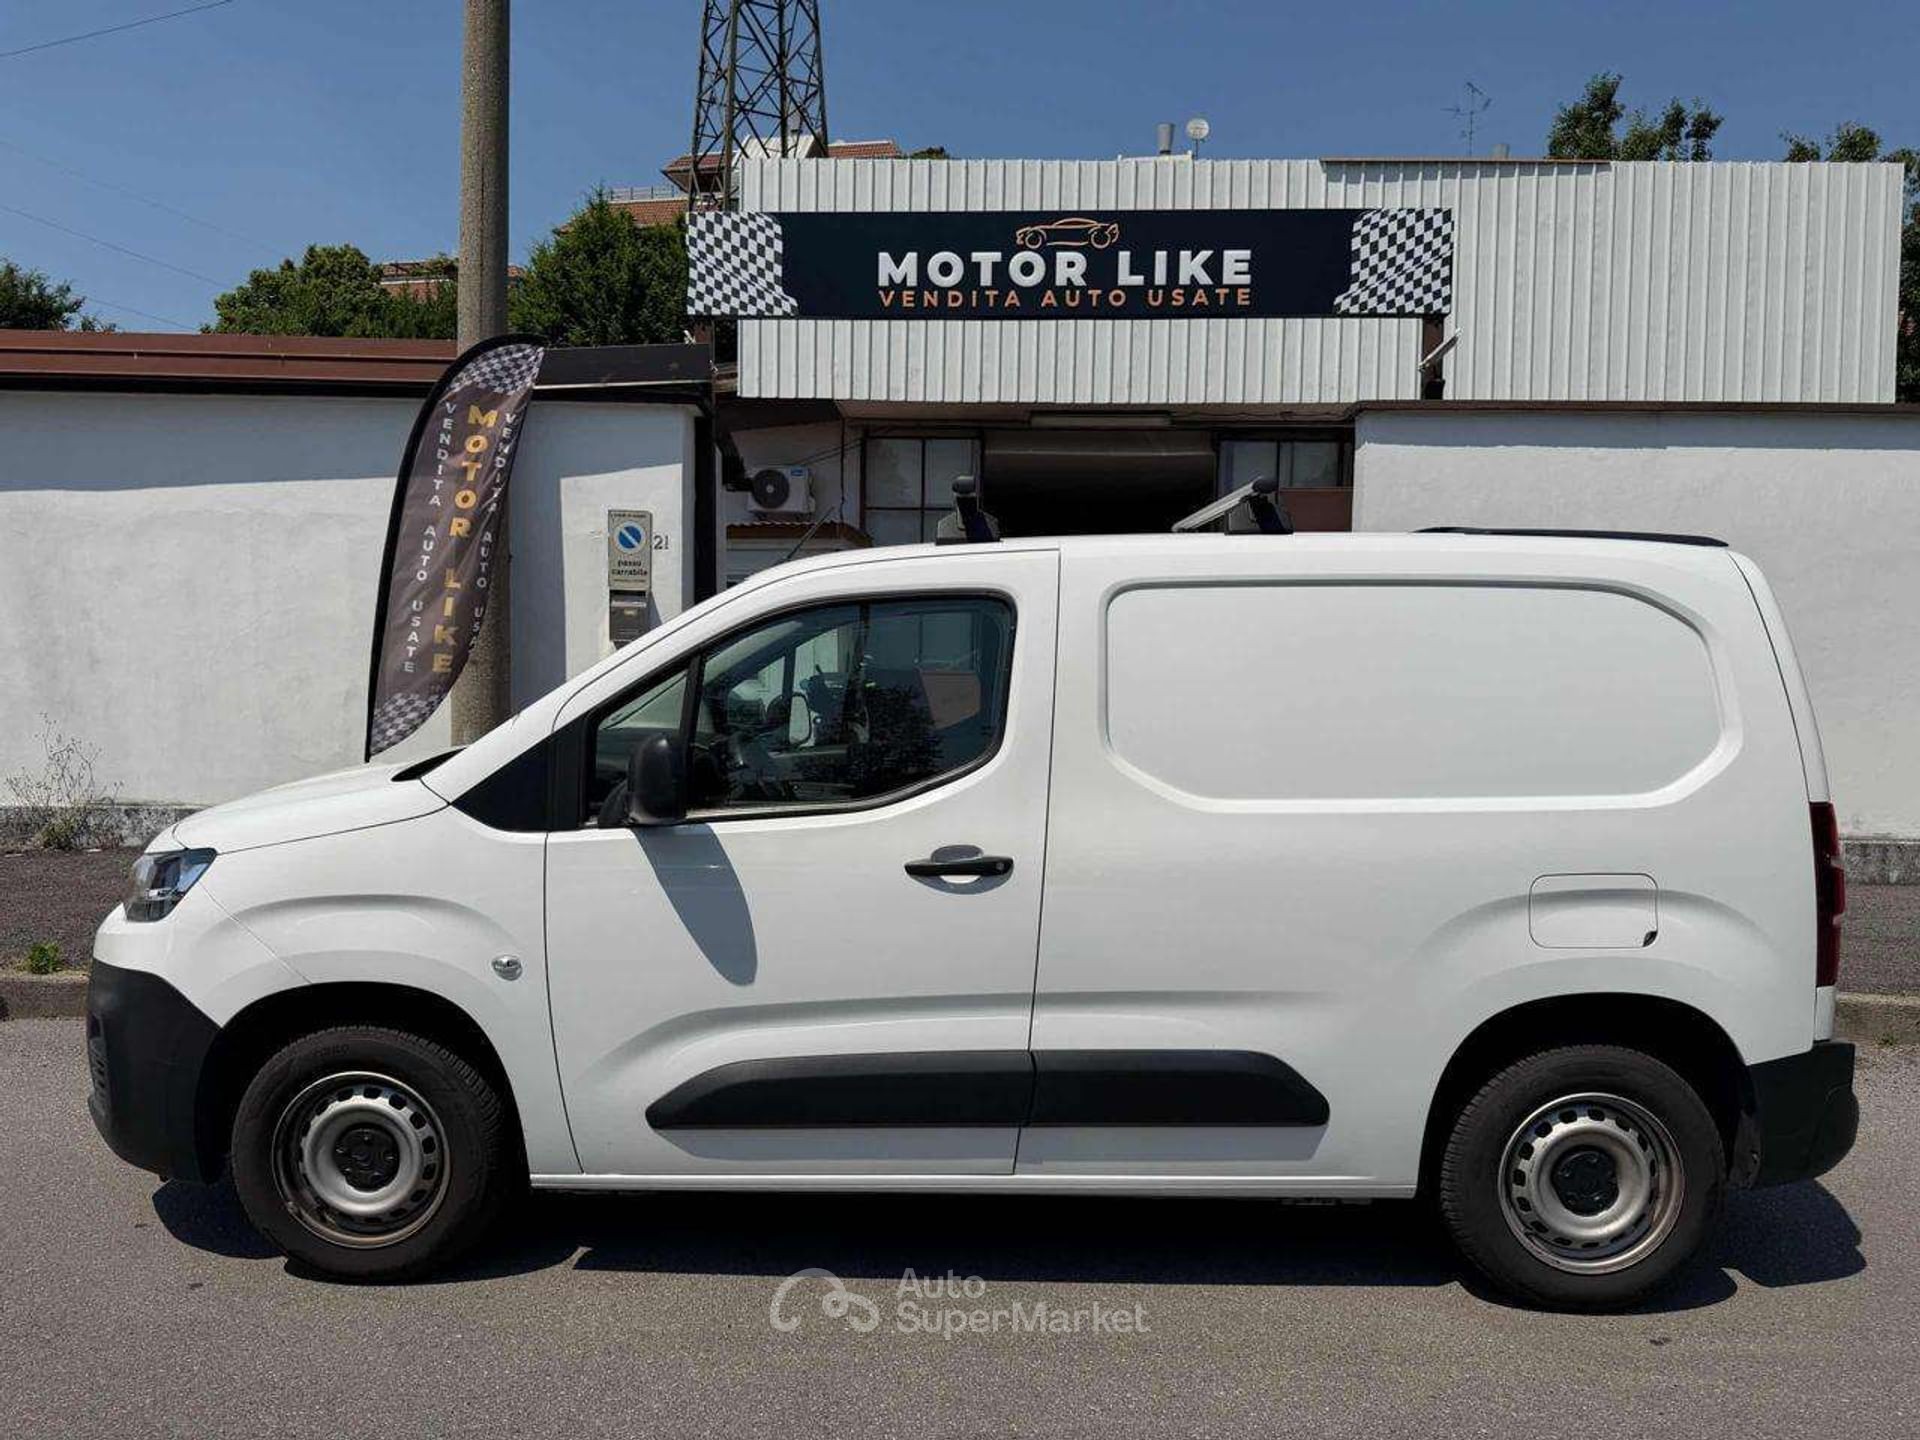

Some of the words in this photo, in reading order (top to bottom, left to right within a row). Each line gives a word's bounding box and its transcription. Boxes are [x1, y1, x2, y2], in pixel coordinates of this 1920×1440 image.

[878, 250, 1087, 288] MOTOR
[1117, 250, 1252, 286] LIKE
[879, 290, 1020, 308] VENDITA
[1041, 289, 1127, 307] AUTO
[1148, 288, 1251, 306] USATE
[429, 402, 457, 506] VENDITA
[449, 404, 498, 537] MOTOR
[487, 412, 518, 512] VENDITA
[416, 525, 436, 581] AUTO
[477, 531, 493, 588] AUTO
[654, 535, 669, 550] 21
[404, 600, 423, 673] USATE
[432, 568, 461, 673] LIKE
